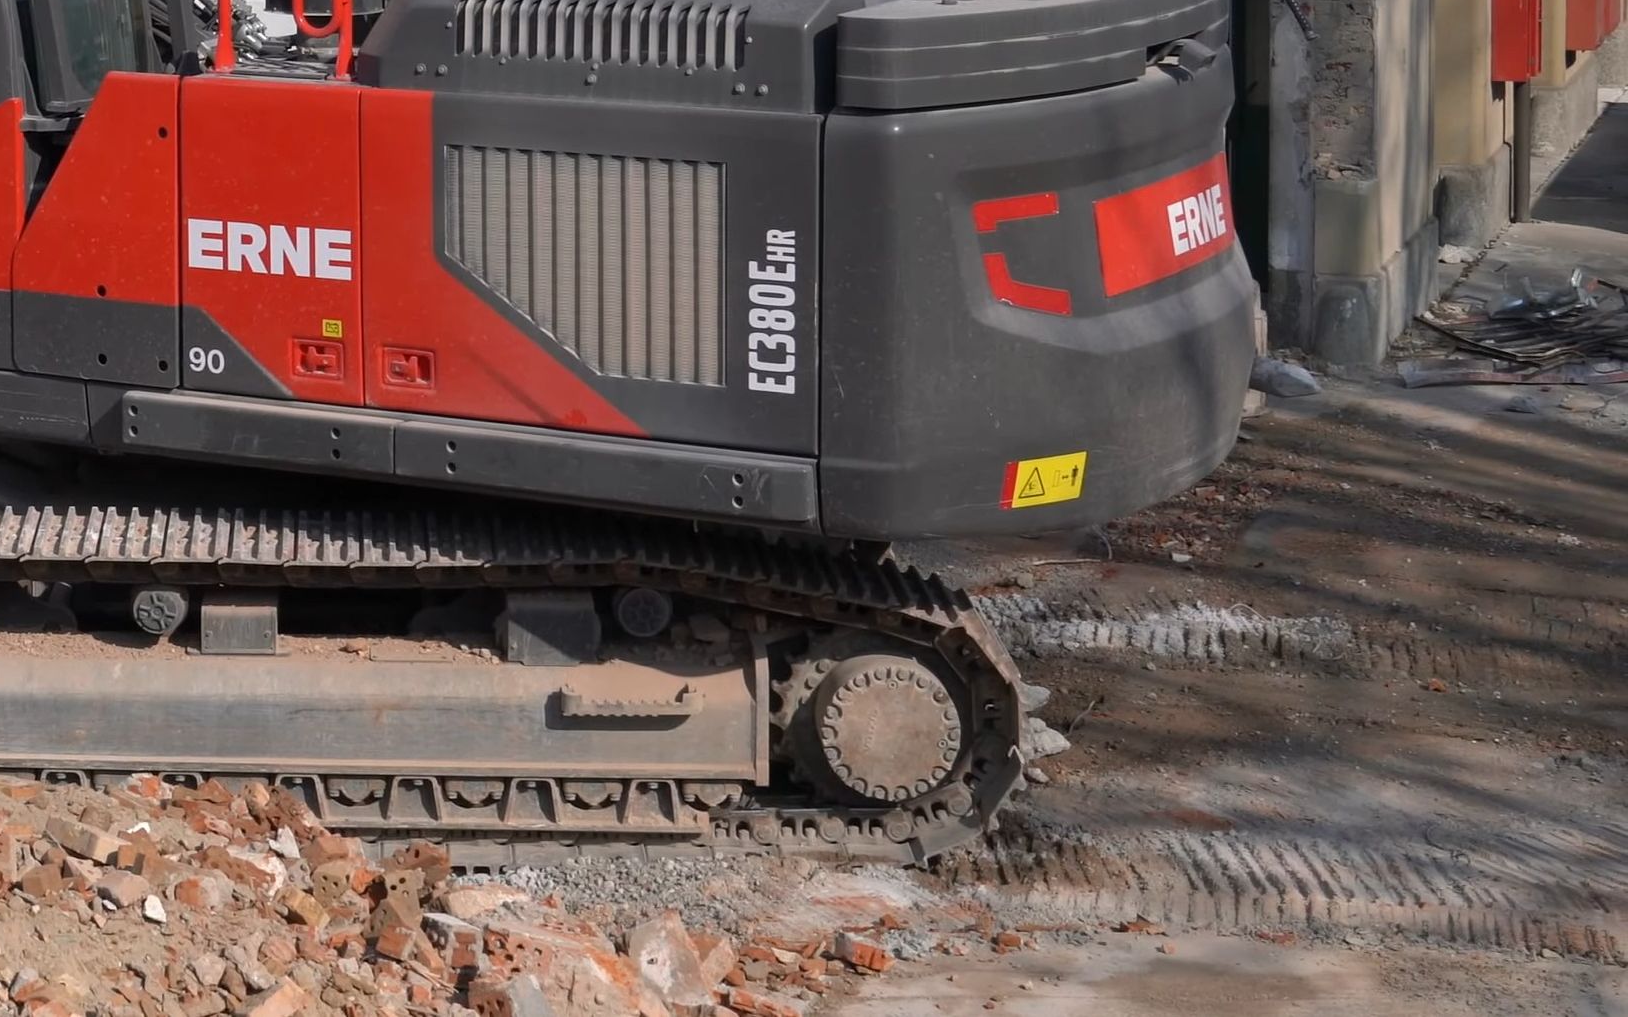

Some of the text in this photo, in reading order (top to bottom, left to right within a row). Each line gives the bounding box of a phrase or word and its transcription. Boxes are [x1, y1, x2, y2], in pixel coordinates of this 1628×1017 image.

[187, 218, 352, 281] ERNE
[1167, 184, 1226, 256] ERNE
[188, 346, 225, 375] 90
